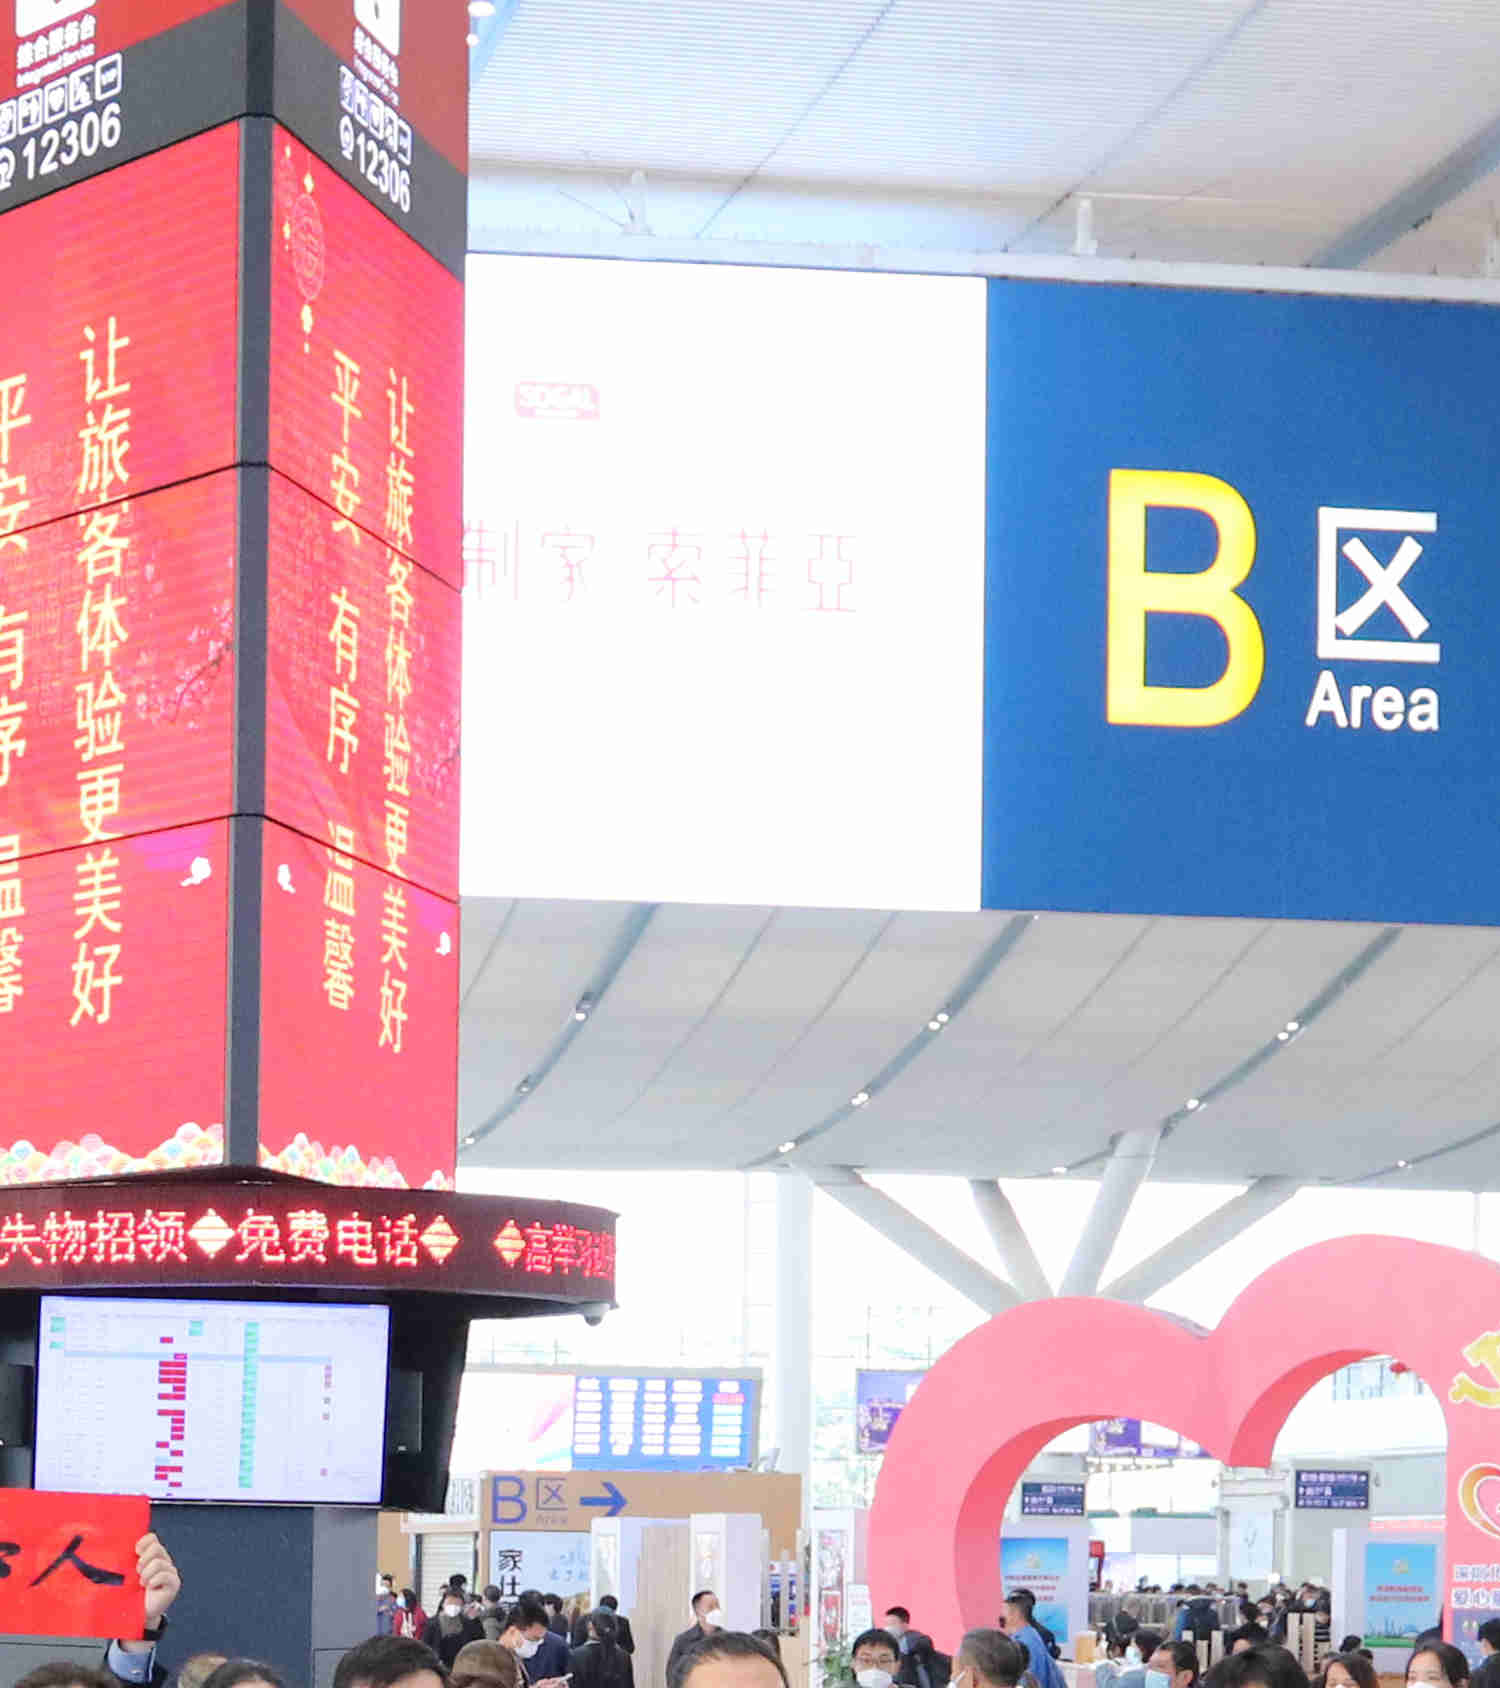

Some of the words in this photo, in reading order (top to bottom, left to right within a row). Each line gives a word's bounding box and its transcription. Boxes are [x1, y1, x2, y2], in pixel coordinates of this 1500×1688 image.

[23, 102, 121, 180] 12306
[357, 132, 410, 213] 12306
[70, 316, 131, 1026] 让旅客体验更美好
[379, 368, 415, 1053] 让旅客体验更美好
[1306, 670, 1440, 732] Area
